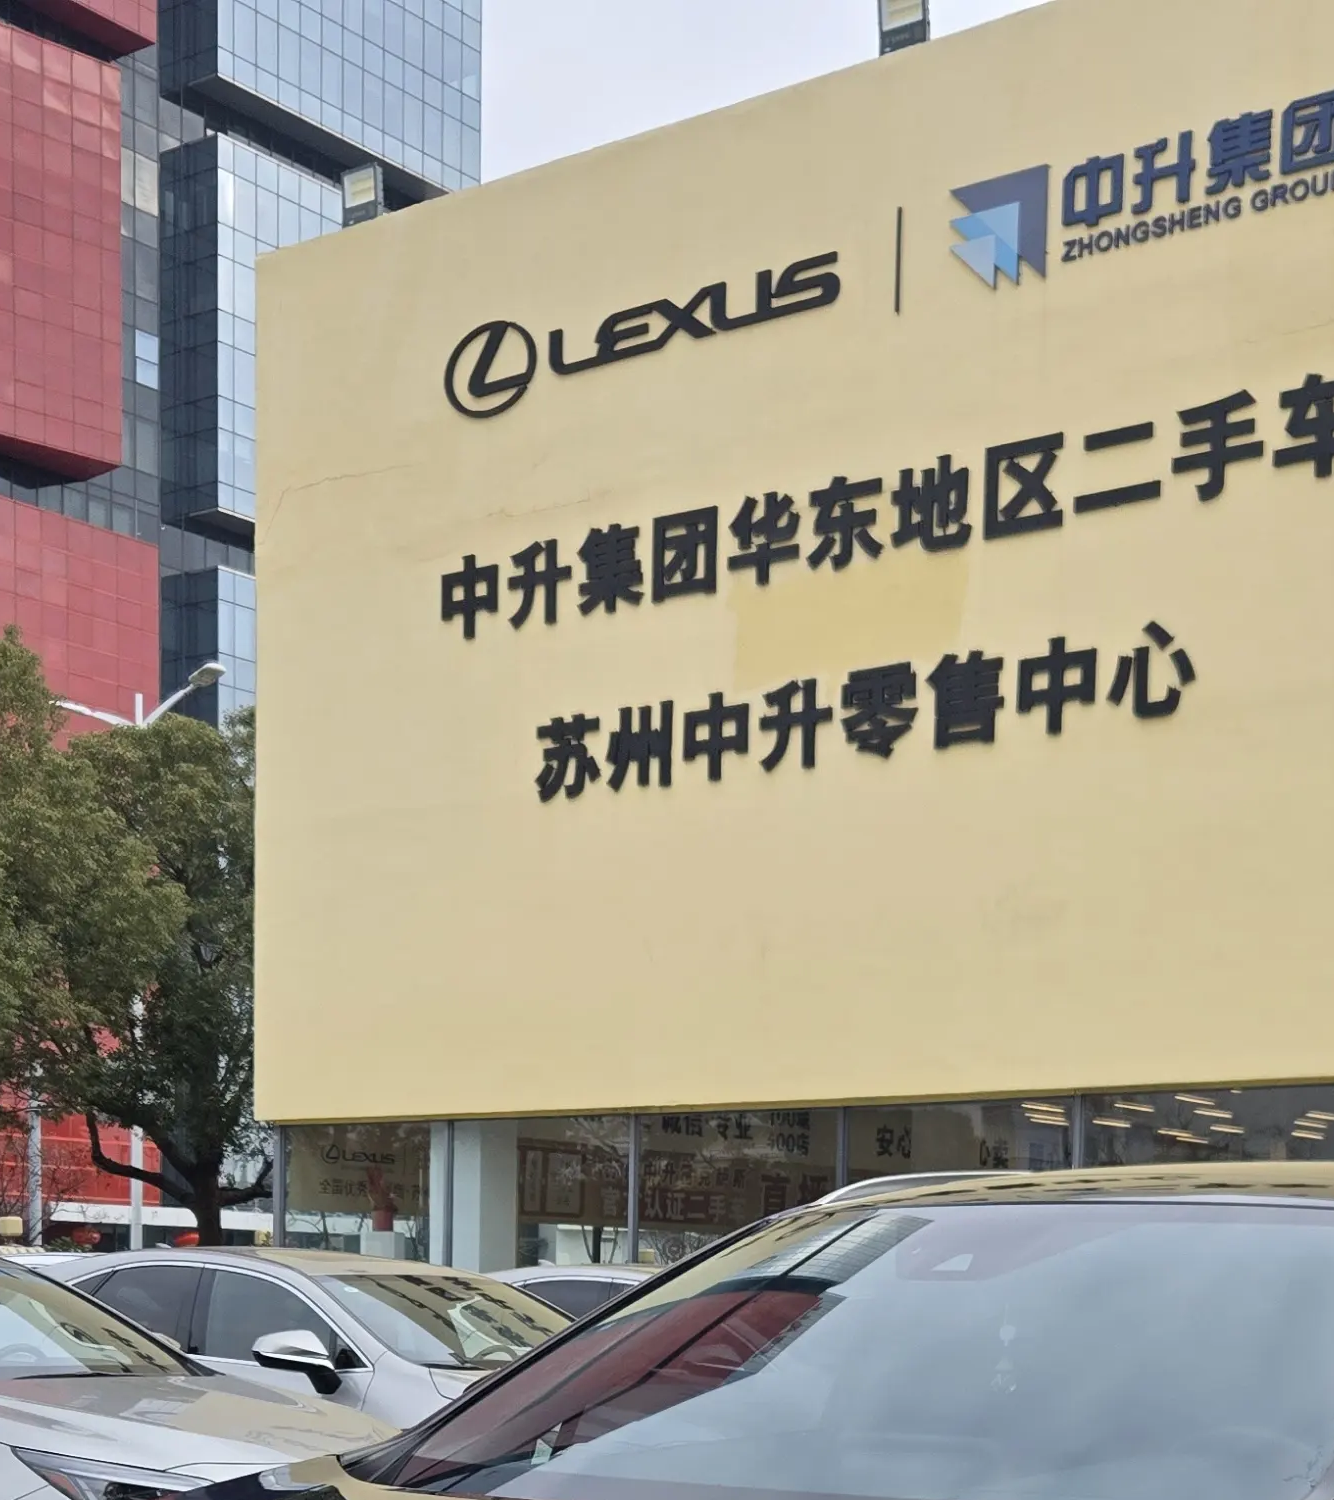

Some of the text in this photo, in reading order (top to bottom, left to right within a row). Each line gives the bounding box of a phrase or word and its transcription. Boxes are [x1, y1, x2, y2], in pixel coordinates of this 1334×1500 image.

[1061, 196, 1242, 263] ZHONGSHENG
[548, 250, 841, 376] LEXUS
[534, 620, 1197, 803] 苏州中升零售中心
[342, 1150, 396, 1165] LEXUS
